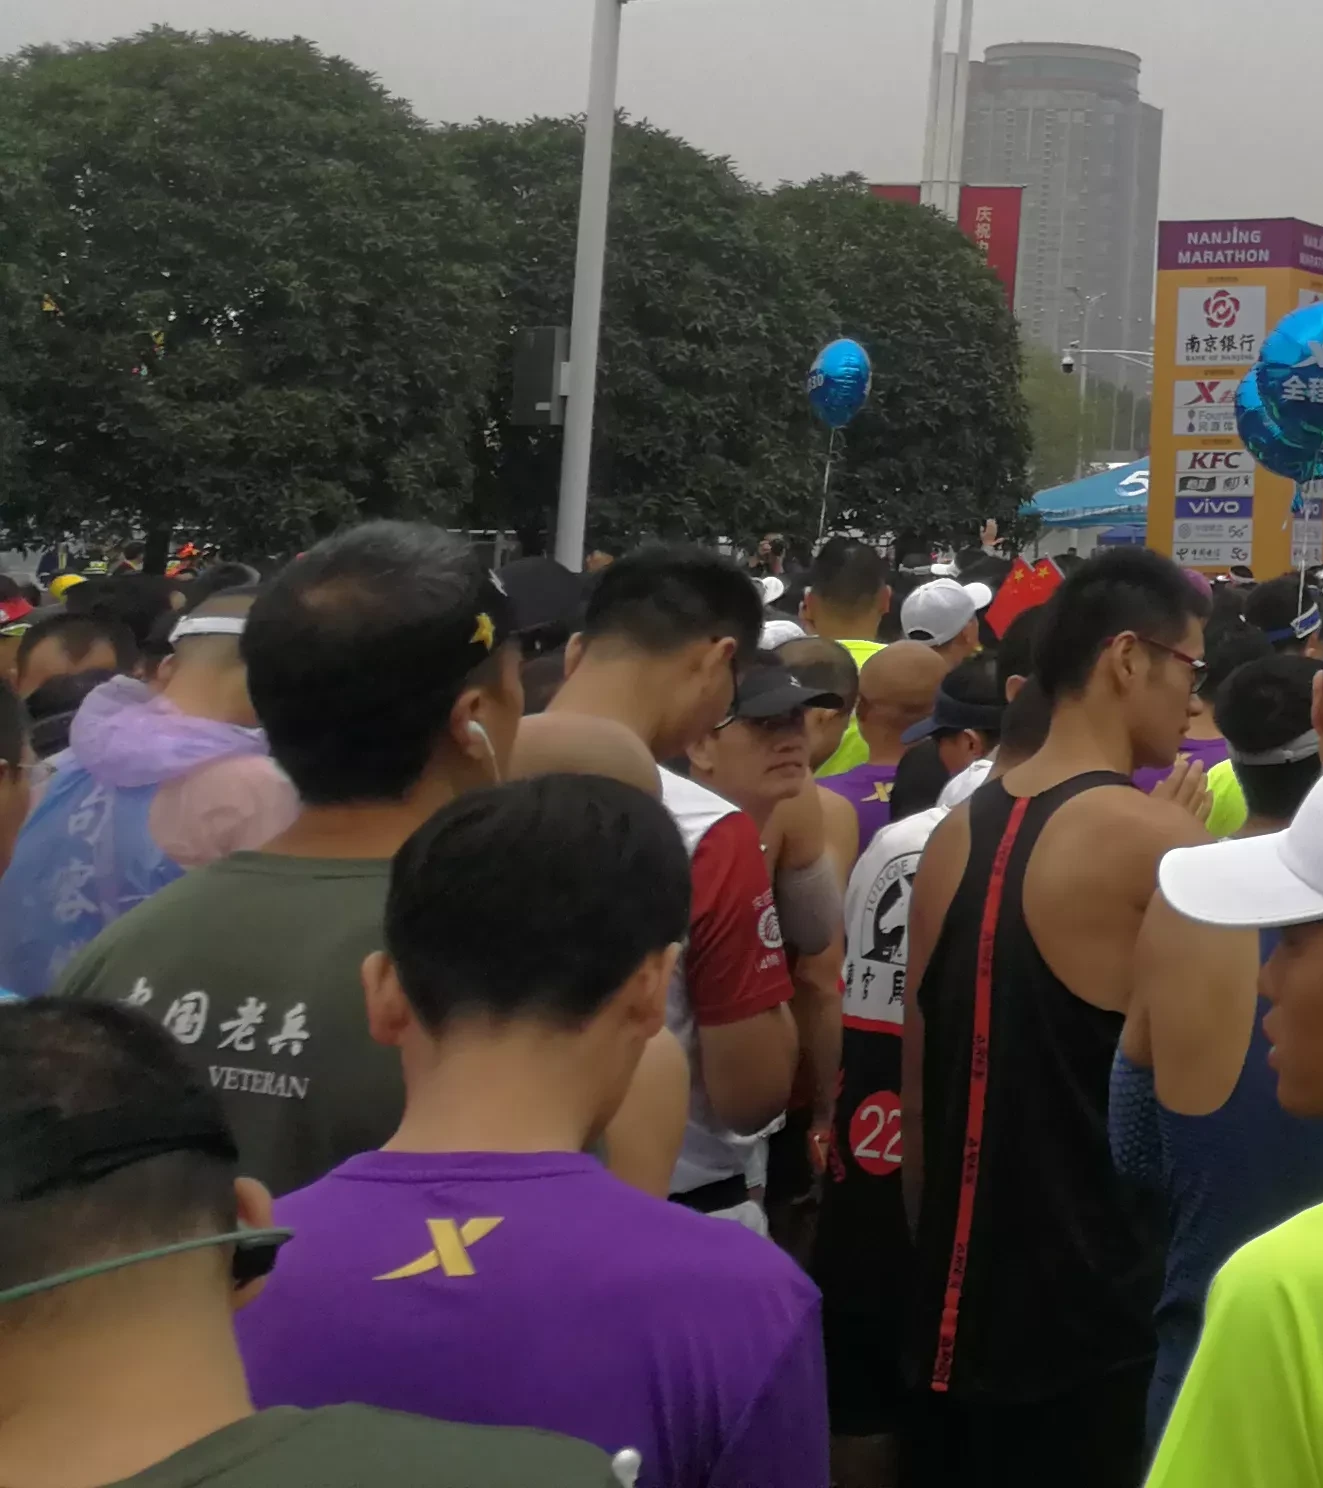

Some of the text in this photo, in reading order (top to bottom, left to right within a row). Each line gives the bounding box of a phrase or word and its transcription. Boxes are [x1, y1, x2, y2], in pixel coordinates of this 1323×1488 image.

[1187, 226, 1262, 245] NANJING
[1178, 249, 1270, 264] MARATHON
[1185, 333, 1256, 354] 南京银行
[1188, 451, 1244, 470] KFC
[208, 1065, 310, 1100] VETERAN
